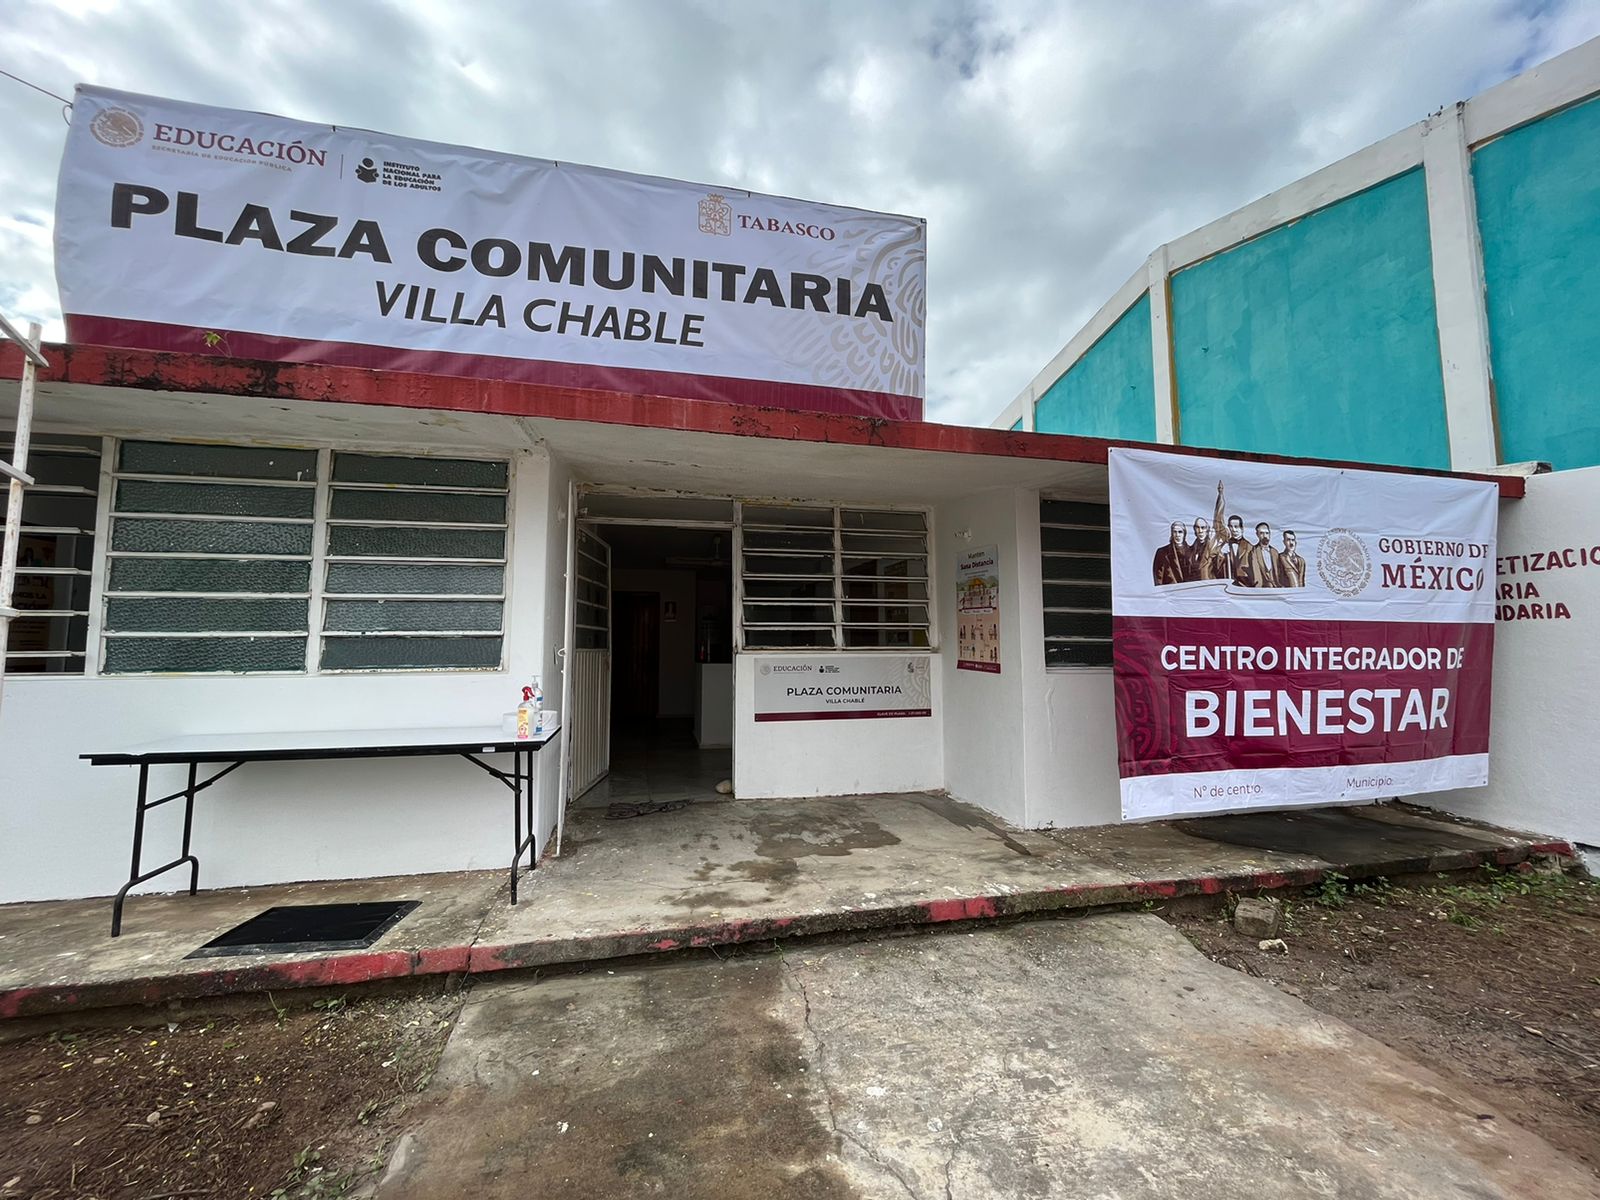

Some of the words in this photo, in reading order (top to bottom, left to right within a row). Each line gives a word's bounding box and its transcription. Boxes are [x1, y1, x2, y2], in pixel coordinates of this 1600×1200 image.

[153, 123, 327, 167] EDUCACIÓN
[383, 161, 420, 172] INSTITUTO
[383, 167, 420, 178] NACIONAL
[422, 173, 442, 181] PARA
[394, 175, 435, 185] EDUCACIÓN
[410, 184, 442, 192] ADULTOS
[737, 214, 836, 242] TABASCO
[110, 182, 393, 264] PLAZA
[416, 227, 894, 323] COMUNITARIA
[375, 280, 507, 329] VILLA
[523, 298, 706, 348] CHABLE
[1379, 538, 1464, 558] GOBIERNO
[1381, 556, 1484, 592] MÉXICO
[773, 664, 813, 672] EDUCACIÓN
[1160, 645, 1279, 671] CENTRO
[1285, 646, 1442, 671] INTEGRADOR
[1446, 647, 1465, 670] DE
[786, 687, 823, 696] PLAZA
[826, 685, 902, 696] COMUNITARIA
[1185, 688, 1450, 737] BIENESTAR
[1209, 785, 1224, 798] de
